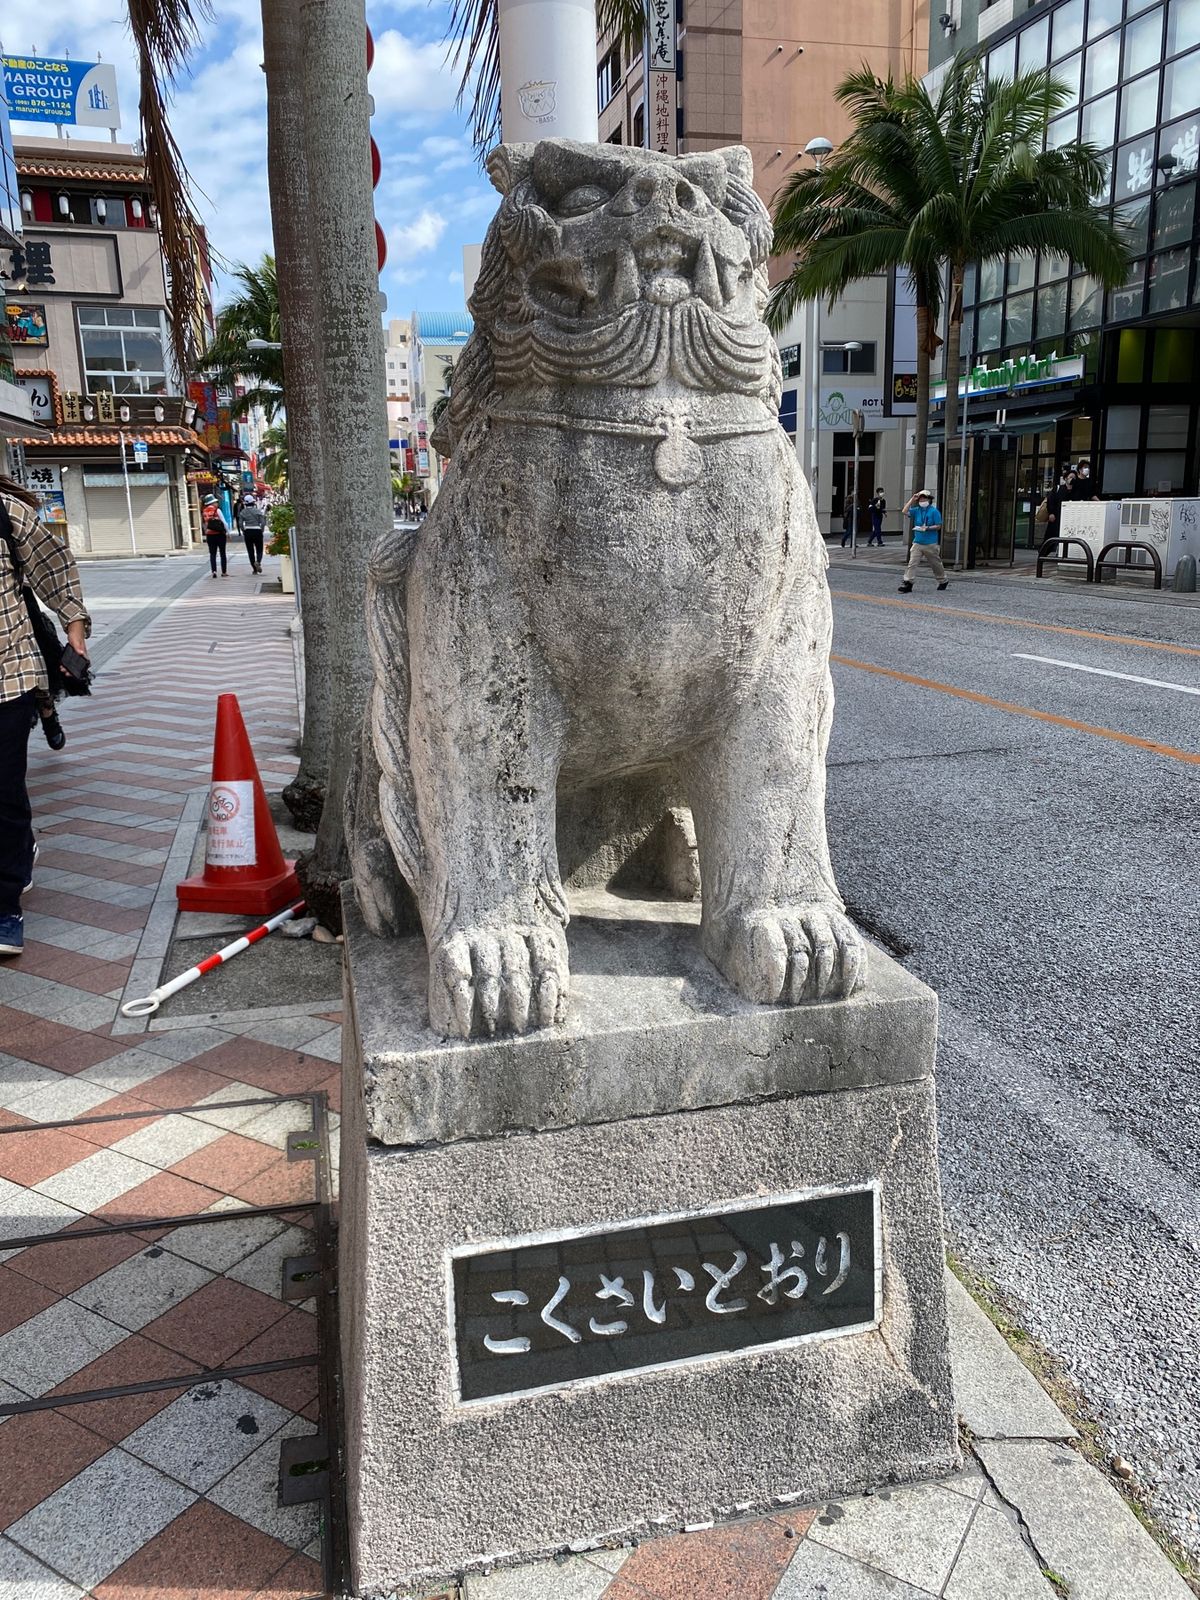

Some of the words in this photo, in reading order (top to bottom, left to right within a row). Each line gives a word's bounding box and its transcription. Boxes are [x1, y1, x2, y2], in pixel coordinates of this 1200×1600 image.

[4, 71, 72, 87] MARUYU
[12, 85, 73, 99] GROUP
[973, 354, 1055, 392] FamilyMart
[483, 1231, 851, 1354] こくさいとおり
